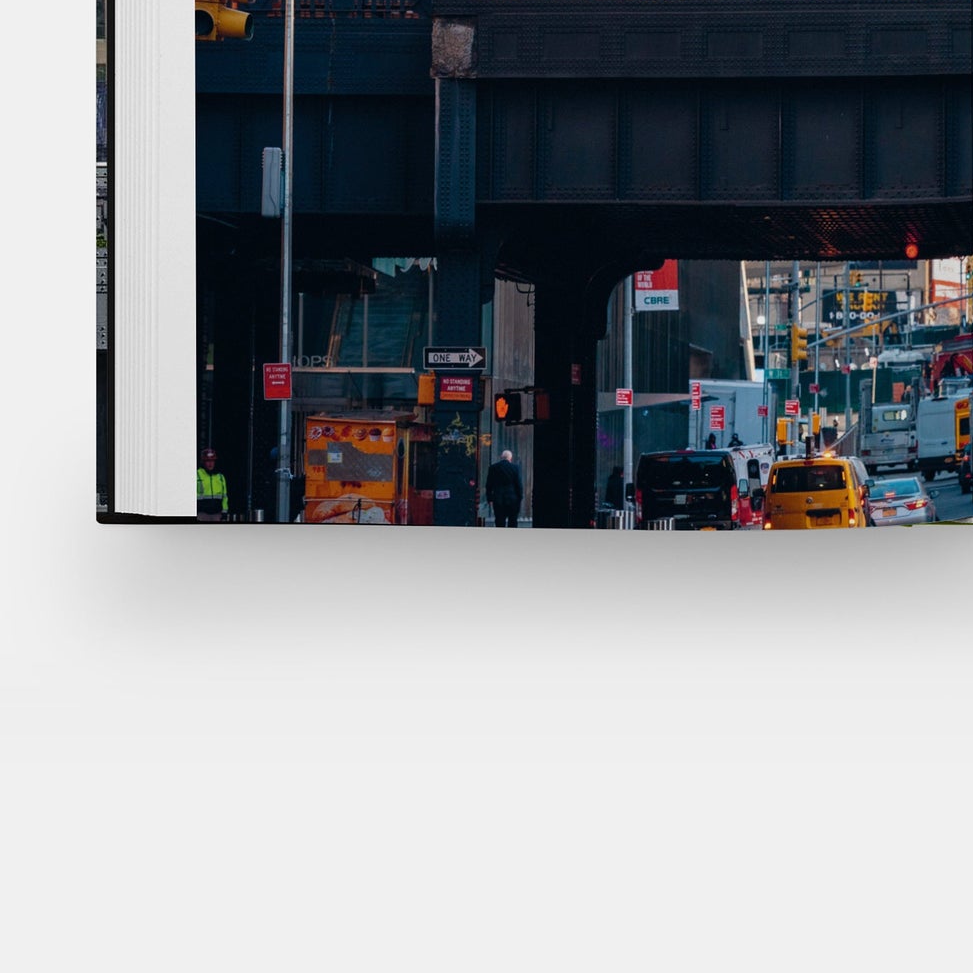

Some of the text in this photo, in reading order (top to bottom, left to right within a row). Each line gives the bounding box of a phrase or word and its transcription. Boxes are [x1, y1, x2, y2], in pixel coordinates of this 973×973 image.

[643, 296, 671, 305] CBRE
[432, 353, 477, 363] ONE WAY
